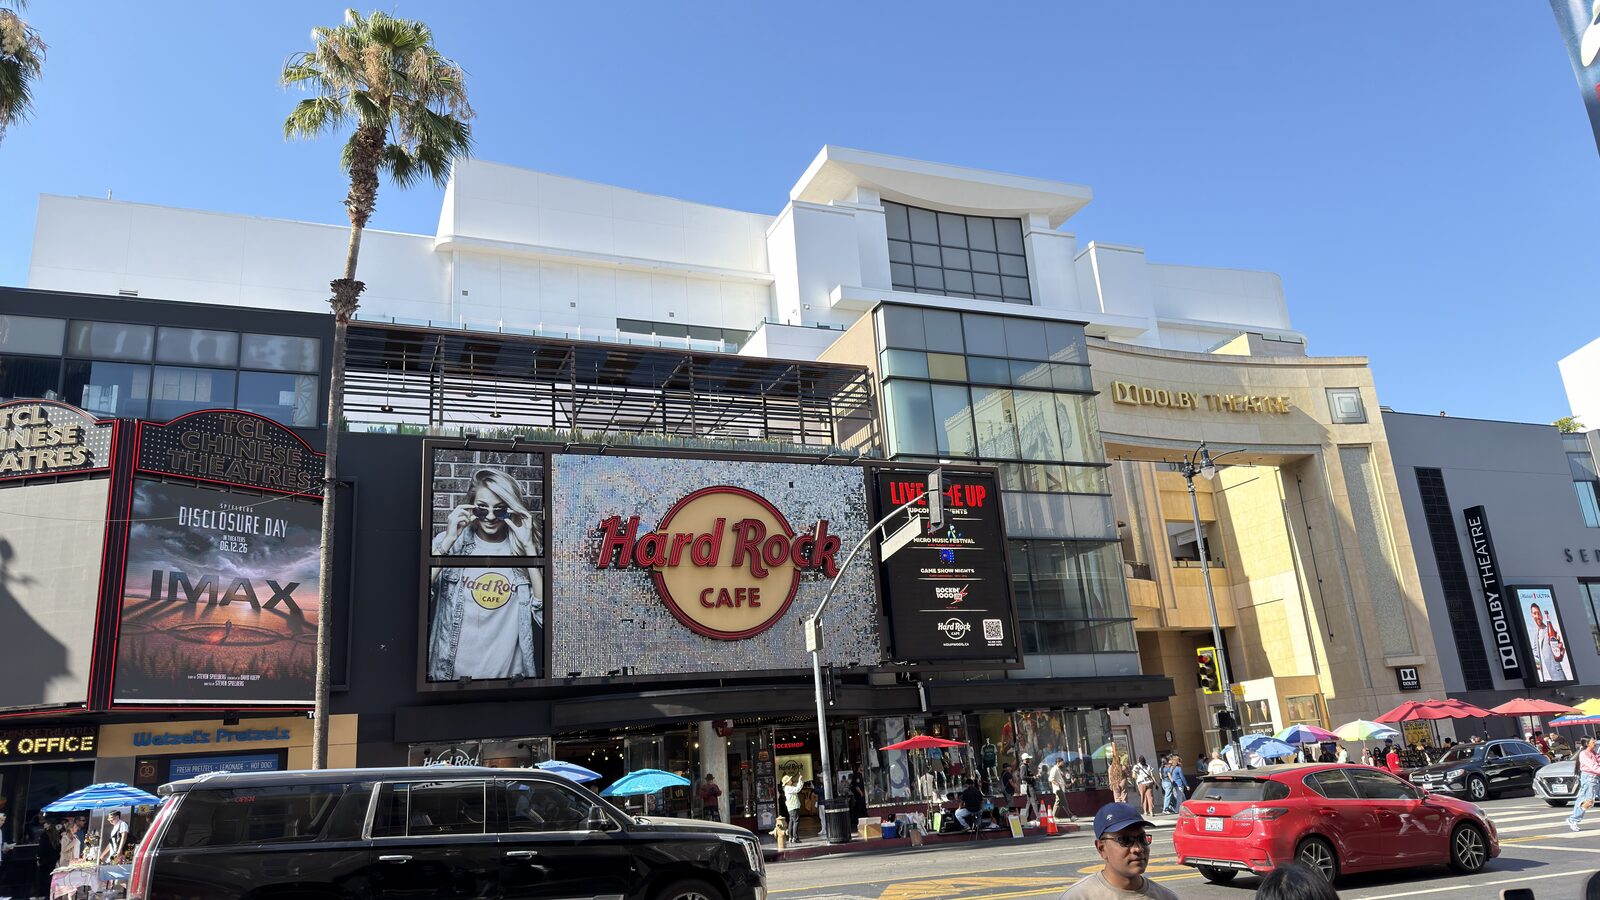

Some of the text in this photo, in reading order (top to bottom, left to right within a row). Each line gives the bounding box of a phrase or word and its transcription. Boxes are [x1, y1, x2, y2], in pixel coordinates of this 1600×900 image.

[1141, 387, 1290, 414] DOLBY THEATRE
[219, 414, 270, 441] TCL
[181, 430, 302, 467] CHINESE
[167, 449, 311, 490] THEATRES
[890, 482, 926, 506] LIVE
[965, 484, 986, 507] UP
[179, 506, 288, 538] DISCLOSURE DAY
[220, 541, 248, 553] 06.12.26
[598, 516, 842, 579] Hard Rock
[1468, 515, 1496, 588] THEATRE
[150, 569, 302, 613] IMAX
[493, 580, 517, 595] Roc
[700, 588, 761, 608] CAFE
[937, 622, 971, 632] Hard Rock
[1486, 592, 1510, 644] DOLBY
[18, 736, 94, 754] OFFICE
[133, 727, 291, 747] Wetzel's Pretzels
[176, 765, 191, 773] FRESH
[191, 764, 213, 773] PRETZELS
[219, 762, 244, 771] LEMONADE
[260, 761, 273, 769] DOGS
